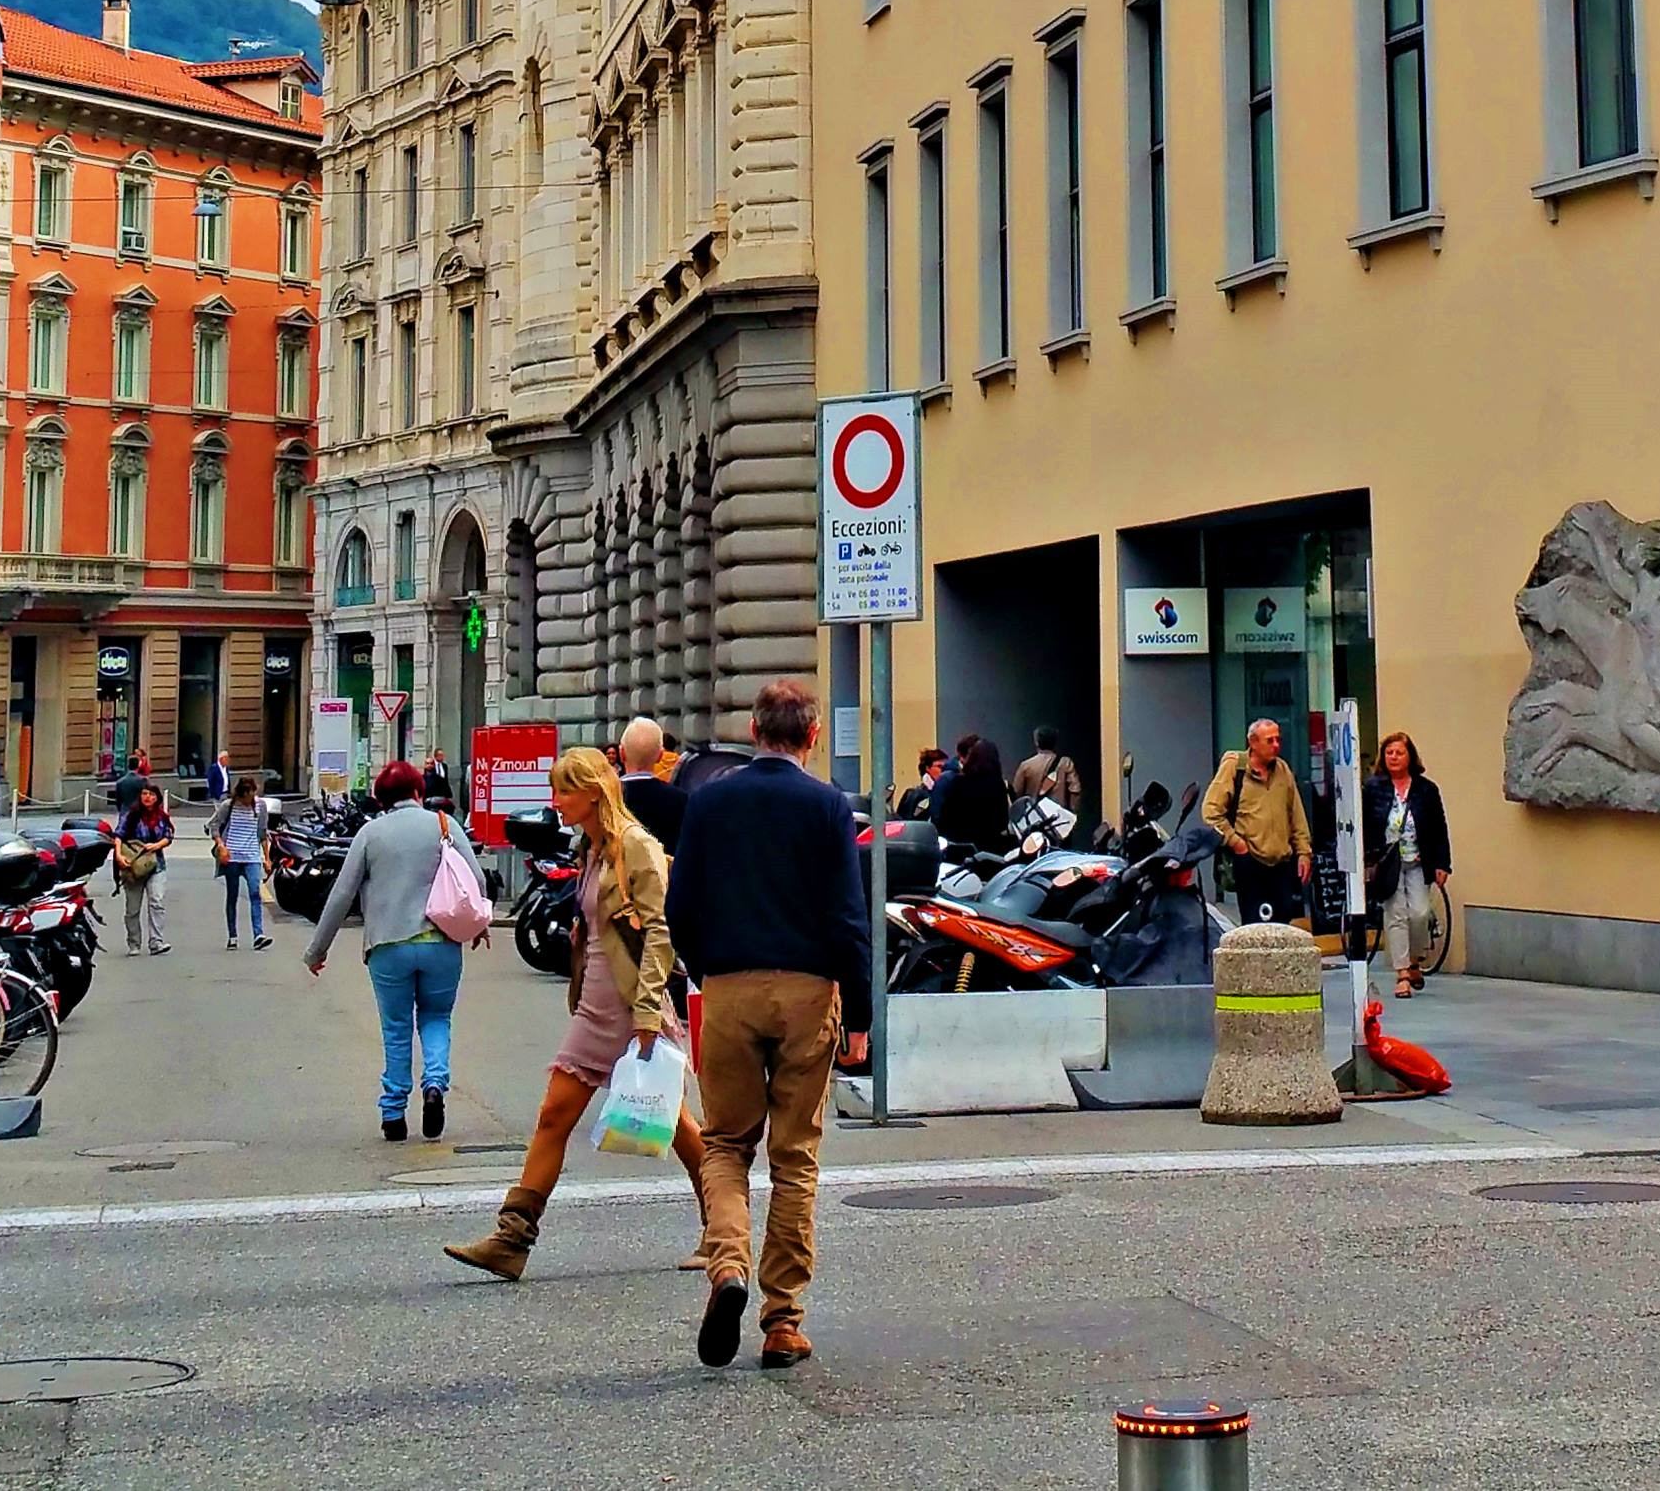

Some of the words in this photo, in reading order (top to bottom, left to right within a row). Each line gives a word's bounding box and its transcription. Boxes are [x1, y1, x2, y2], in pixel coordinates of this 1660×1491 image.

[832, 515, 907, 538] Eccezioni:
[838, 564, 850, 573] per
[851, 562, 872, 571] uscita
[874, 560, 892, 570] dalla
[838, 575, 855, 584] zona
[856, 572, 889, 585] pedonale
[847, 591, 857, 599] Ve
[1137, 630, 1199, 644] swisscom
[492, 757, 537, 771] Zimoun
